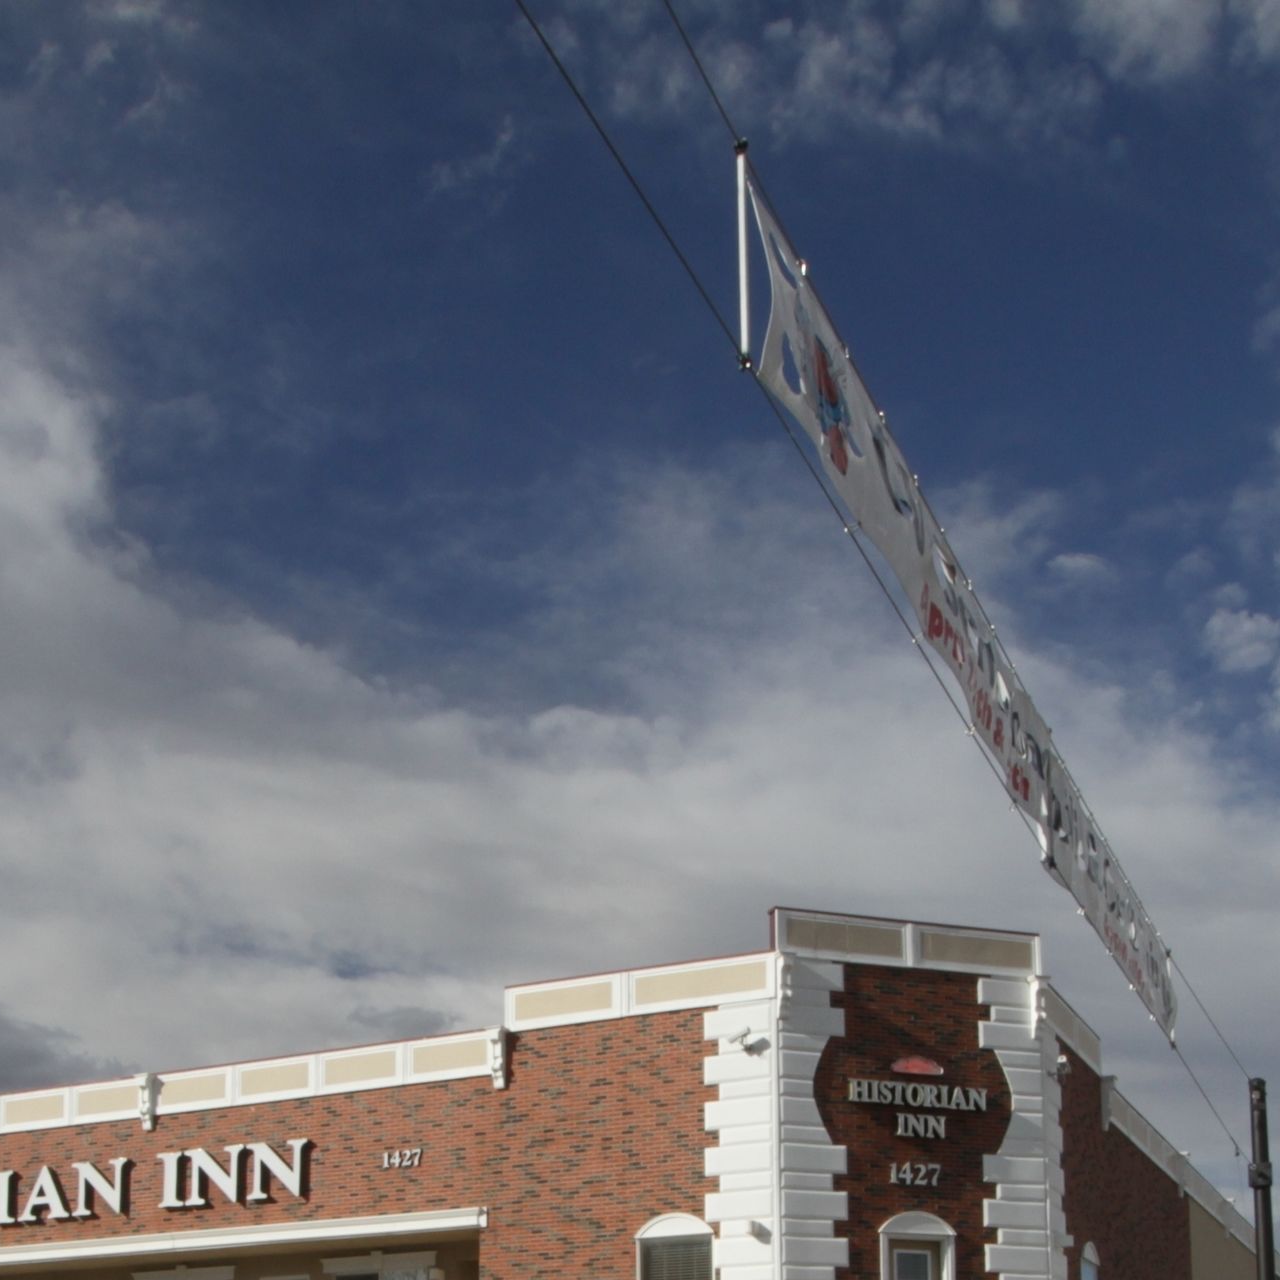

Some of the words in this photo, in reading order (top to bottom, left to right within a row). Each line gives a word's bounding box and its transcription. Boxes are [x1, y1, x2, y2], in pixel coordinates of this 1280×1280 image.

[848, 1078, 987, 1111] HISTORIAN
[896, 1112, 946, 1139] INN
[383, 1148, 422, 1168] 1427
[156, 1138, 310, 1209] INN
[889, 1161, 941, 1186] 1427
